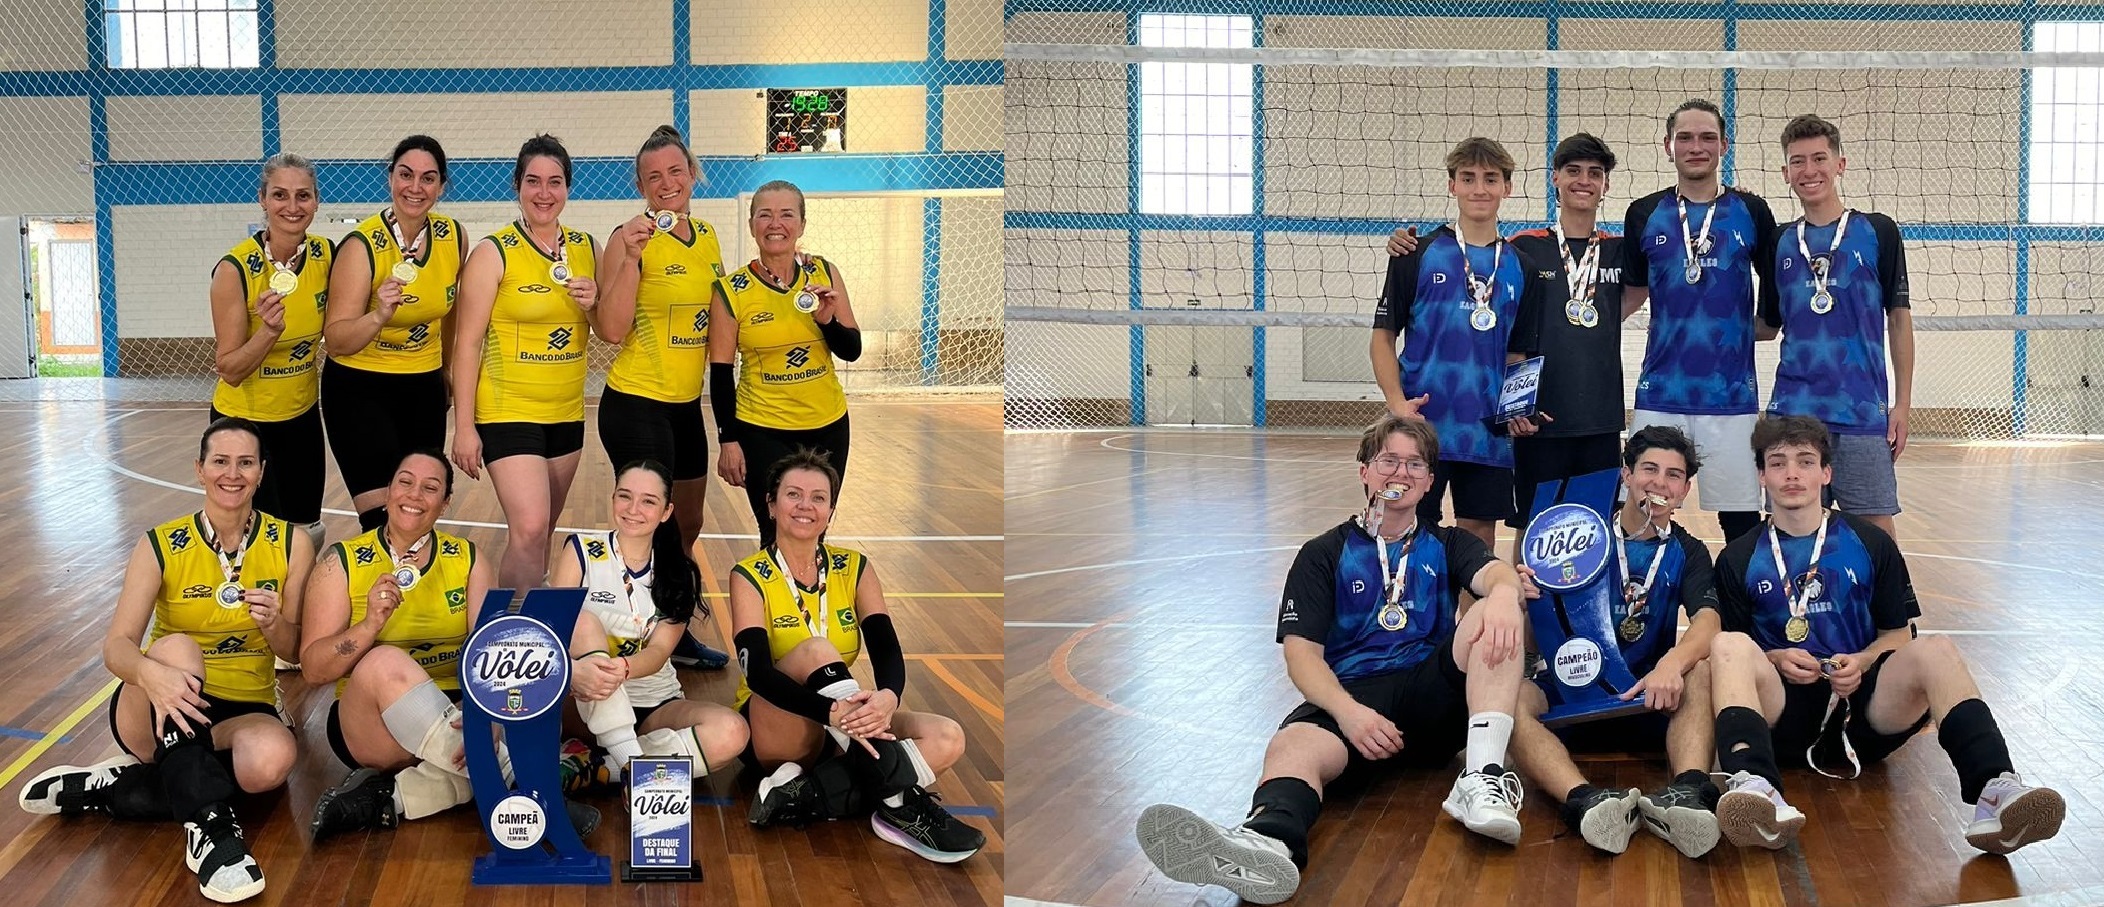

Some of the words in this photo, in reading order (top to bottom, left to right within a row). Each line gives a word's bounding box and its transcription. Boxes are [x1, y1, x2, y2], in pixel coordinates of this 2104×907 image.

[520, 351, 553, 361] BANCO
[554, 353, 566, 361] DO
[263, 366, 295, 375] BANCO
[295, 364, 305, 373] DO
[764, 372, 793, 381] BANCO
[794, 372, 805, 380] DO
[1530, 524, 1597, 560] Vôlei
[421, 655, 437, 666] DO
[438, 648, 462, 661] BRA
[1557, 649, 1598, 666] CAMPEÃO
[472, 649, 554, 680] Vôlei
[1569, 664, 1588, 674] LIVRE
[634, 794, 690, 815] Vôlei
[498, 810, 539, 824] CAMPEÃ
[508, 827, 527, 835] LIVRE
[643, 838, 680, 848] DESTAQUE
[644, 847, 655, 857] DA
[656, 847, 678, 857] FINAL
